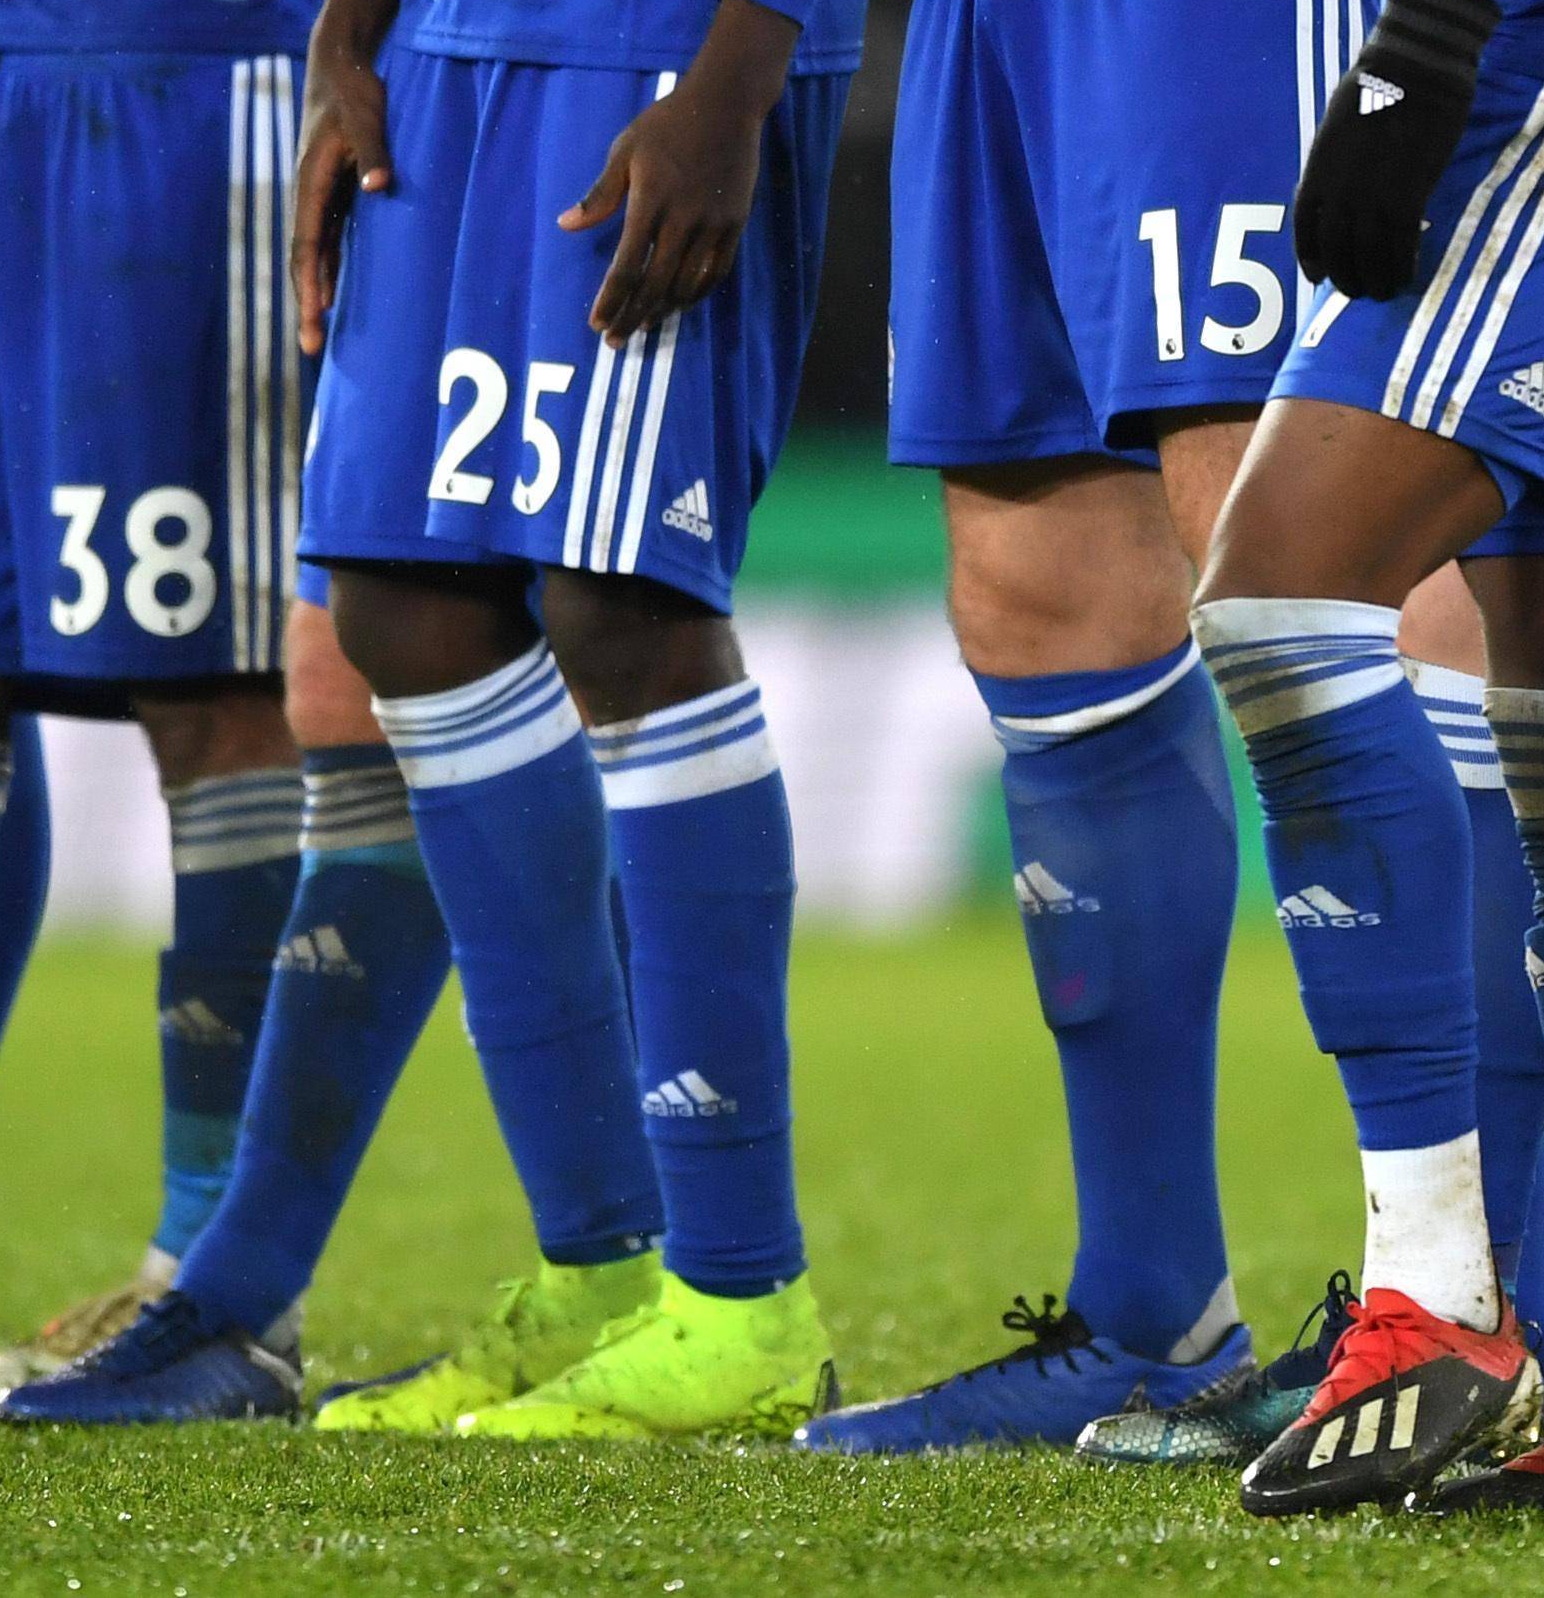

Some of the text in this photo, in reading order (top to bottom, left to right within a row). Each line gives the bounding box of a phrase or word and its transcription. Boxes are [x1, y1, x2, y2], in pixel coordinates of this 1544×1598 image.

[1139, 203, 1287, 361] 15
[427, 347, 576, 516] 25
[49, 485, 218, 637] 38
